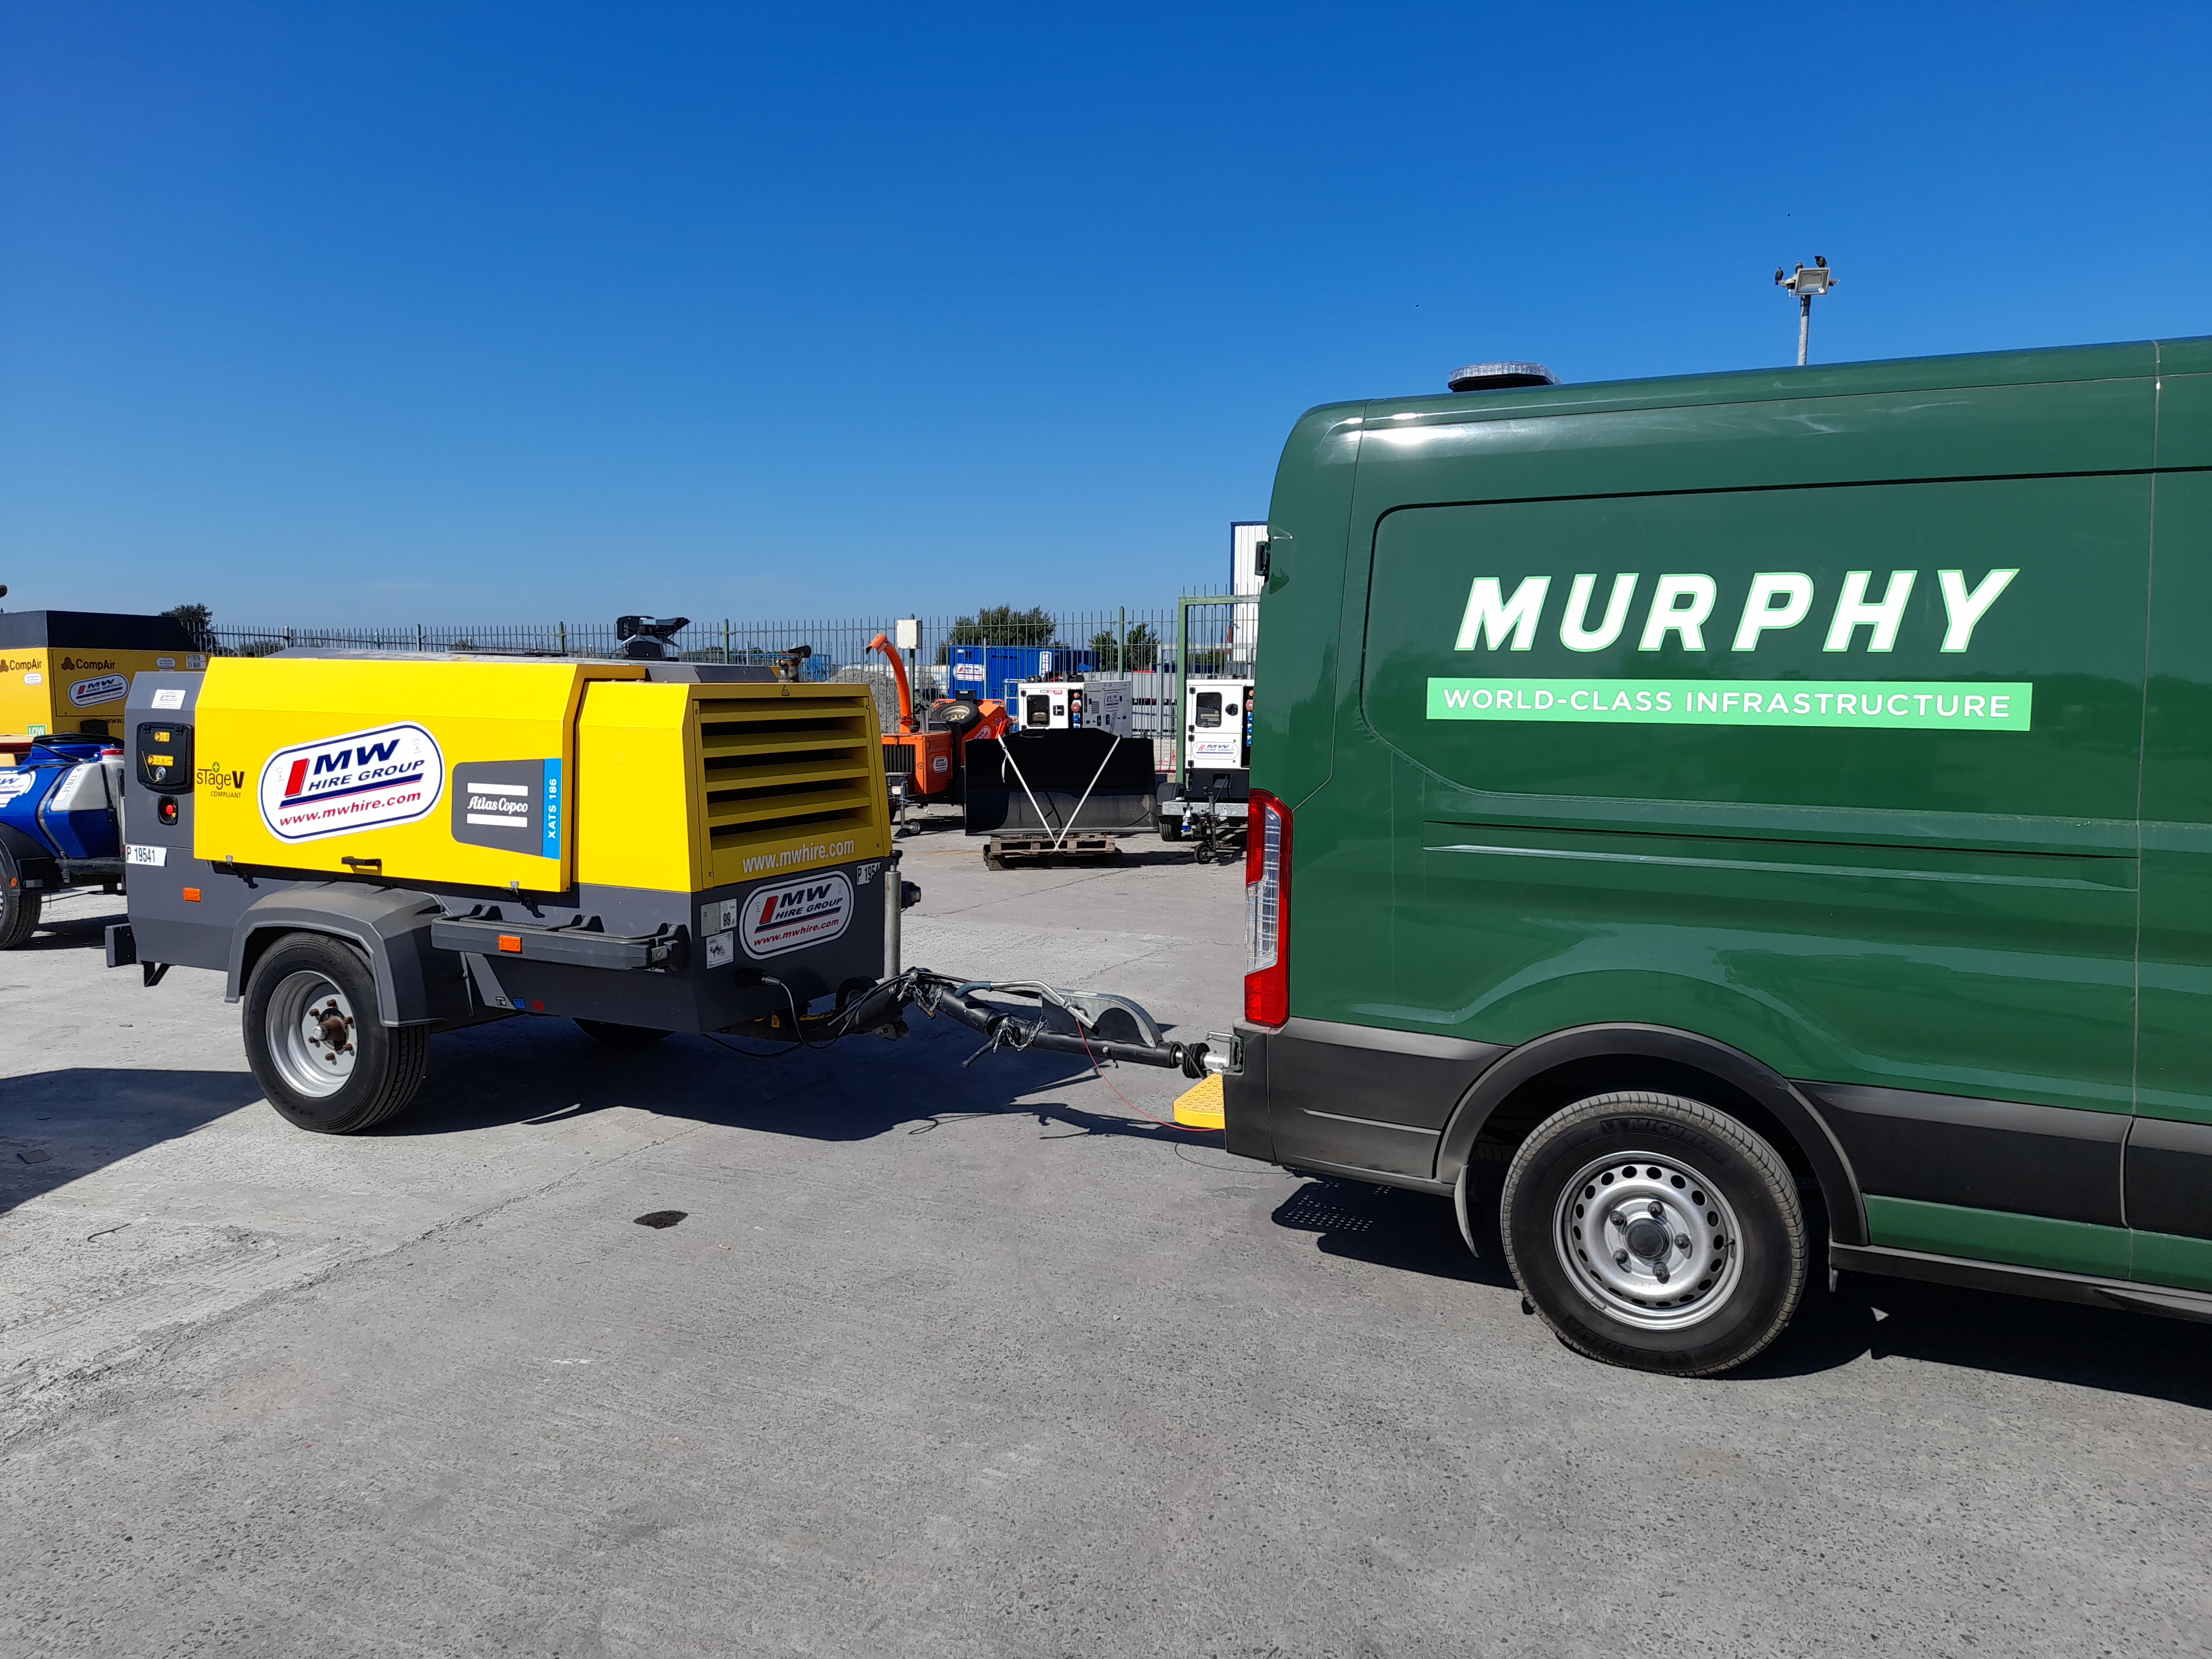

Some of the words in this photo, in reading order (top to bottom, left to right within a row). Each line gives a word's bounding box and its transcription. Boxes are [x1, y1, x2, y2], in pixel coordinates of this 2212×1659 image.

[1454, 568, 2020, 653] MURPHY
[9, 659, 42, 671] CompAir
[76, 659, 116, 671] CompAir
[87, 679, 115, 689] MW
[1444, 688, 1672, 713] WORLD-CLASS
[1686, 691, 2011, 718] INFRASTRUCTURE
[28, 727, 45, 735] LOW
[314, 738, 401, 775] MW
[308, 774, 353, 791] HIRE
[358, 759, 425, 781] GROUP
[549, 779, 557, 800] 186
[280, 792, 421, 826] www.mwhire.com
[467, 796, 497, 811] Atlas
[498, 797, 528, 815] Copco
[548, 805, 557, 839] XATS
[127, 847, 132, 861] P
[134, 847, 155, 863] 19541
[742, 839, 854, 874] www.mwhire.com
[858, 867, 862, 883] P
[779, 884, 833, 909] MW
[775, 907, 804, 920] HIRE
[806, 898, 843, 912] GROUP
[754, 919, 839, 947] www.mwhire.com
